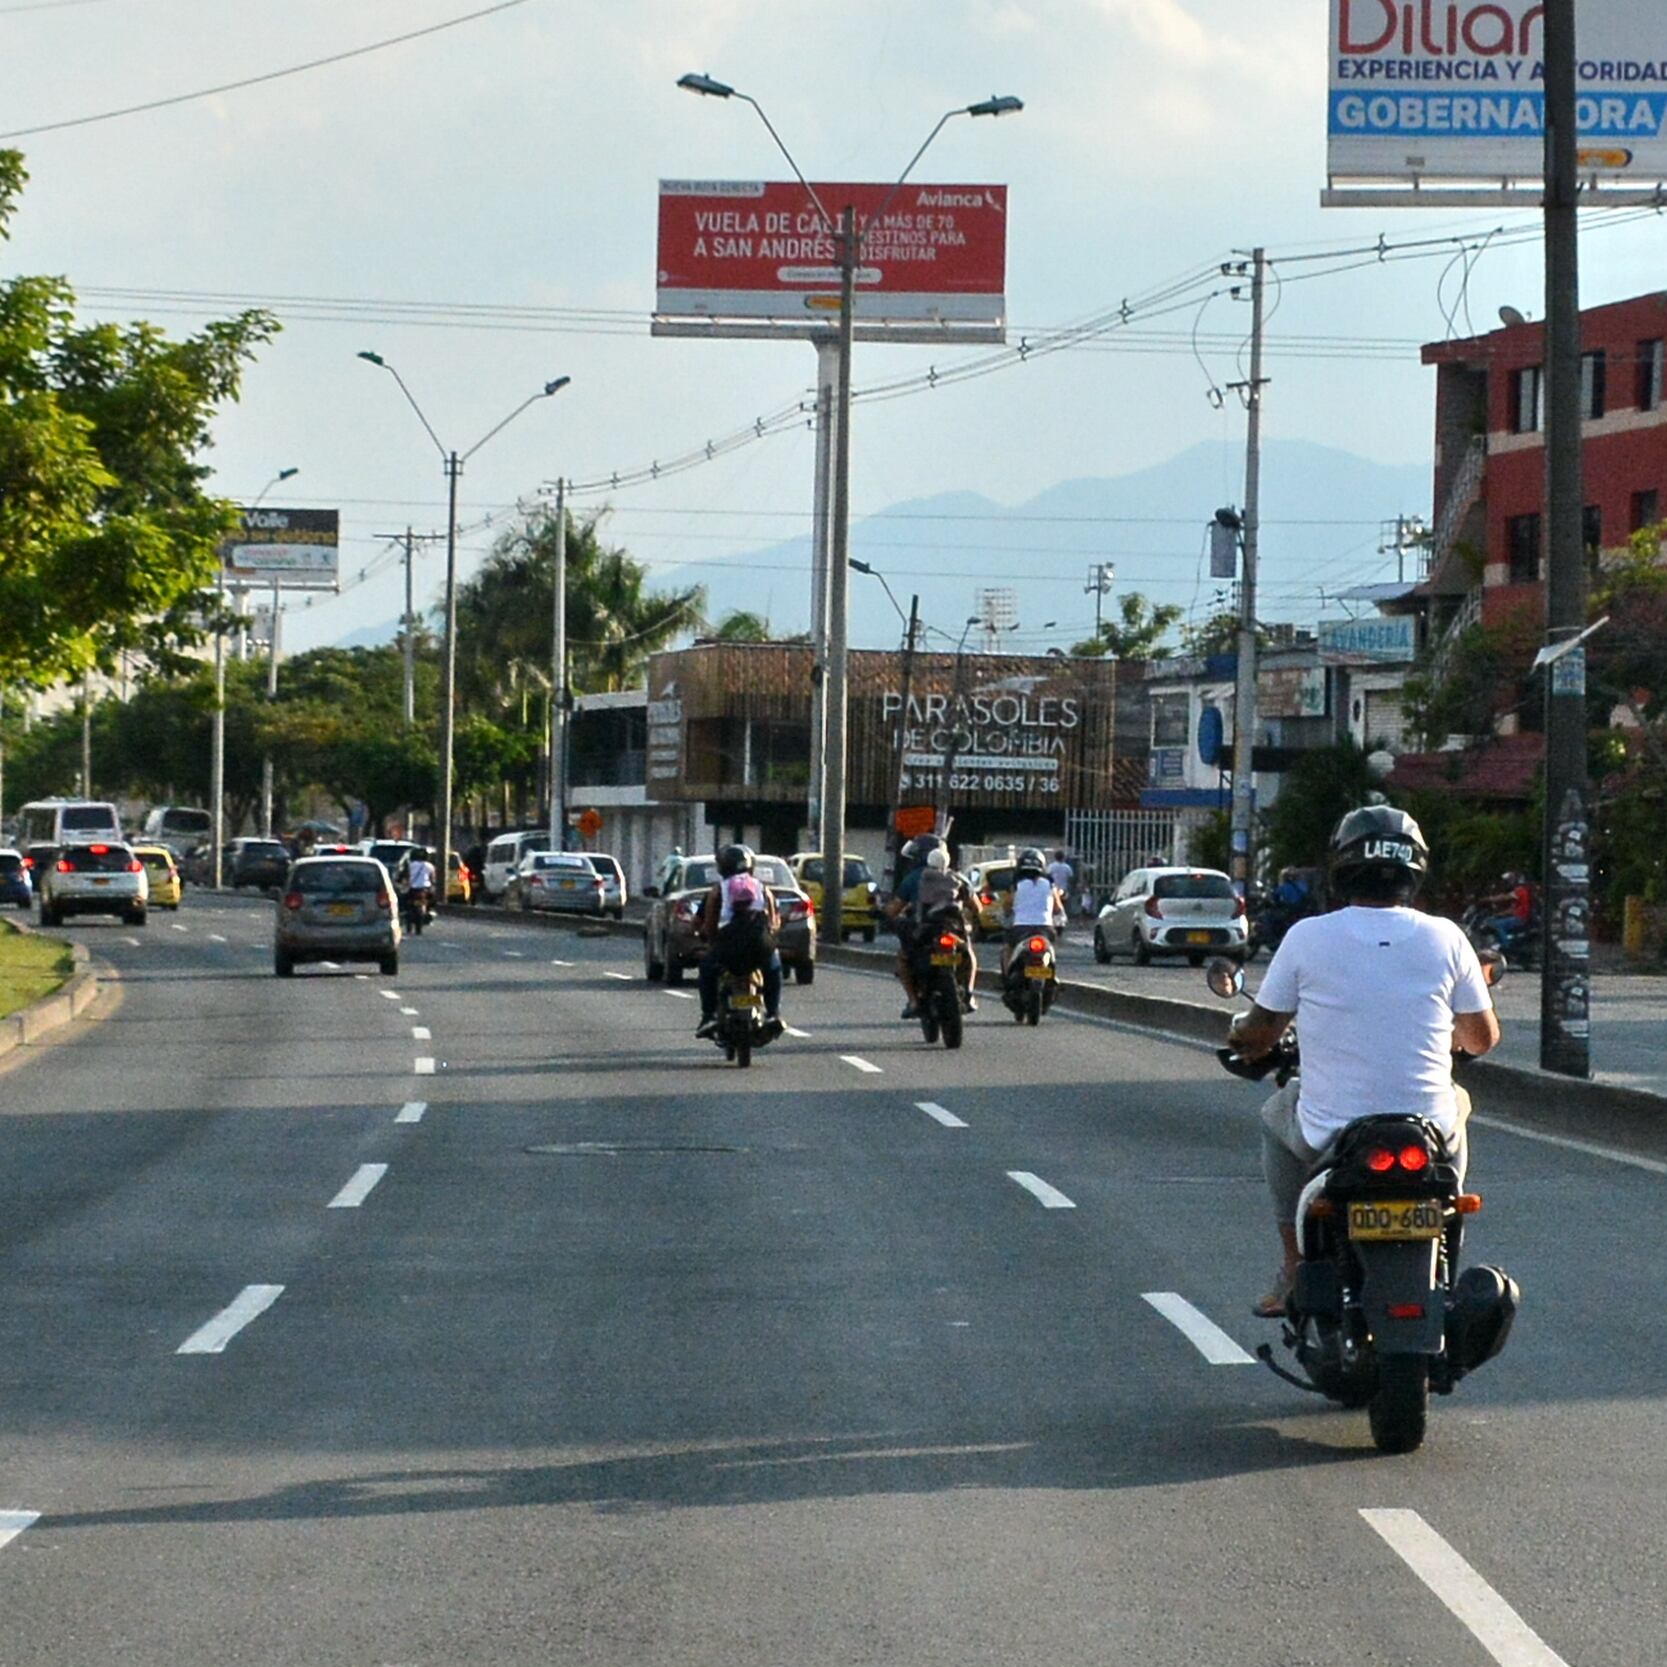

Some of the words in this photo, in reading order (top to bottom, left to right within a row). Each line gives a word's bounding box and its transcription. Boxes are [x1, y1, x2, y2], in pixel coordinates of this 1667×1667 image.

[1338, 59, 1501, 80] EXPERIENCIA
[1505, 60, 1523, 80] Y
[1337, 96, 1657, 130] GOBERNAORA
[695, 212, 760, 232] VUELA
[765, 213, 790, 233] DE
[916, 216, 933, 229] DE
[938, 215, 954, 229] 70
[694, 238, 707, 257] A
[714, 237, 752, 258] SAN
[931, 231, 966, 245] PARA
[883, 691, 1079, 728] PARASOLES
[893, 728, 925, 750] DE
[931, 728, 1066, 754] COLOMBIA
[915, 774, 942, 789] 311
[950, 774, 980, 790] 622
[984, 776, 1025, 791] 0635
[1040, 778, 1060, 793] 36
